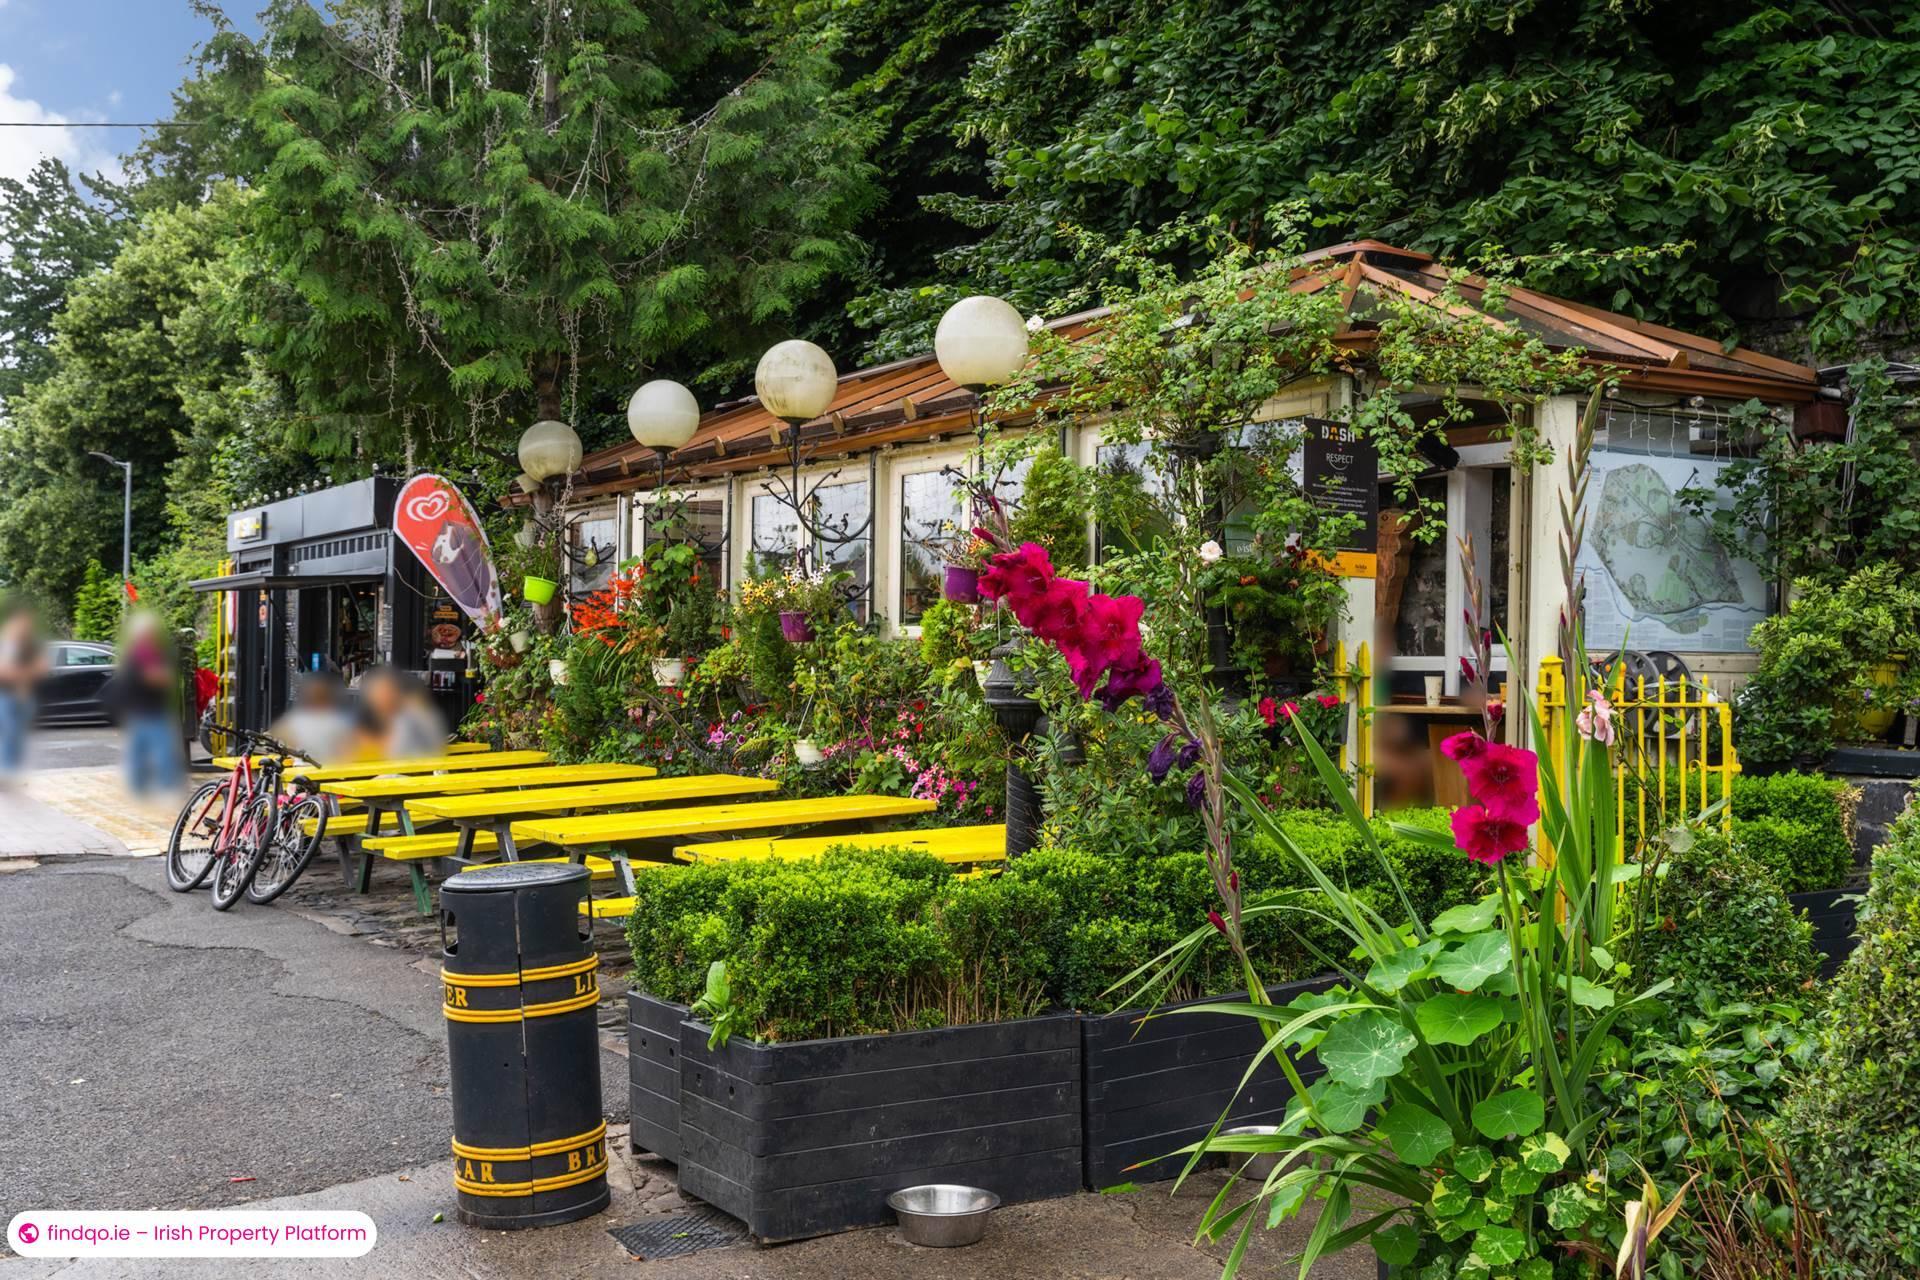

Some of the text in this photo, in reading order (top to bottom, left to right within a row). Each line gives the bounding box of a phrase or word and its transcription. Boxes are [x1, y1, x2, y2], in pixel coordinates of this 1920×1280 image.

[1321, 425, 1356, 444] DASH
[1325, 451, 1355, 465] RESPECT
[445, 984, 469, 1008] ER
